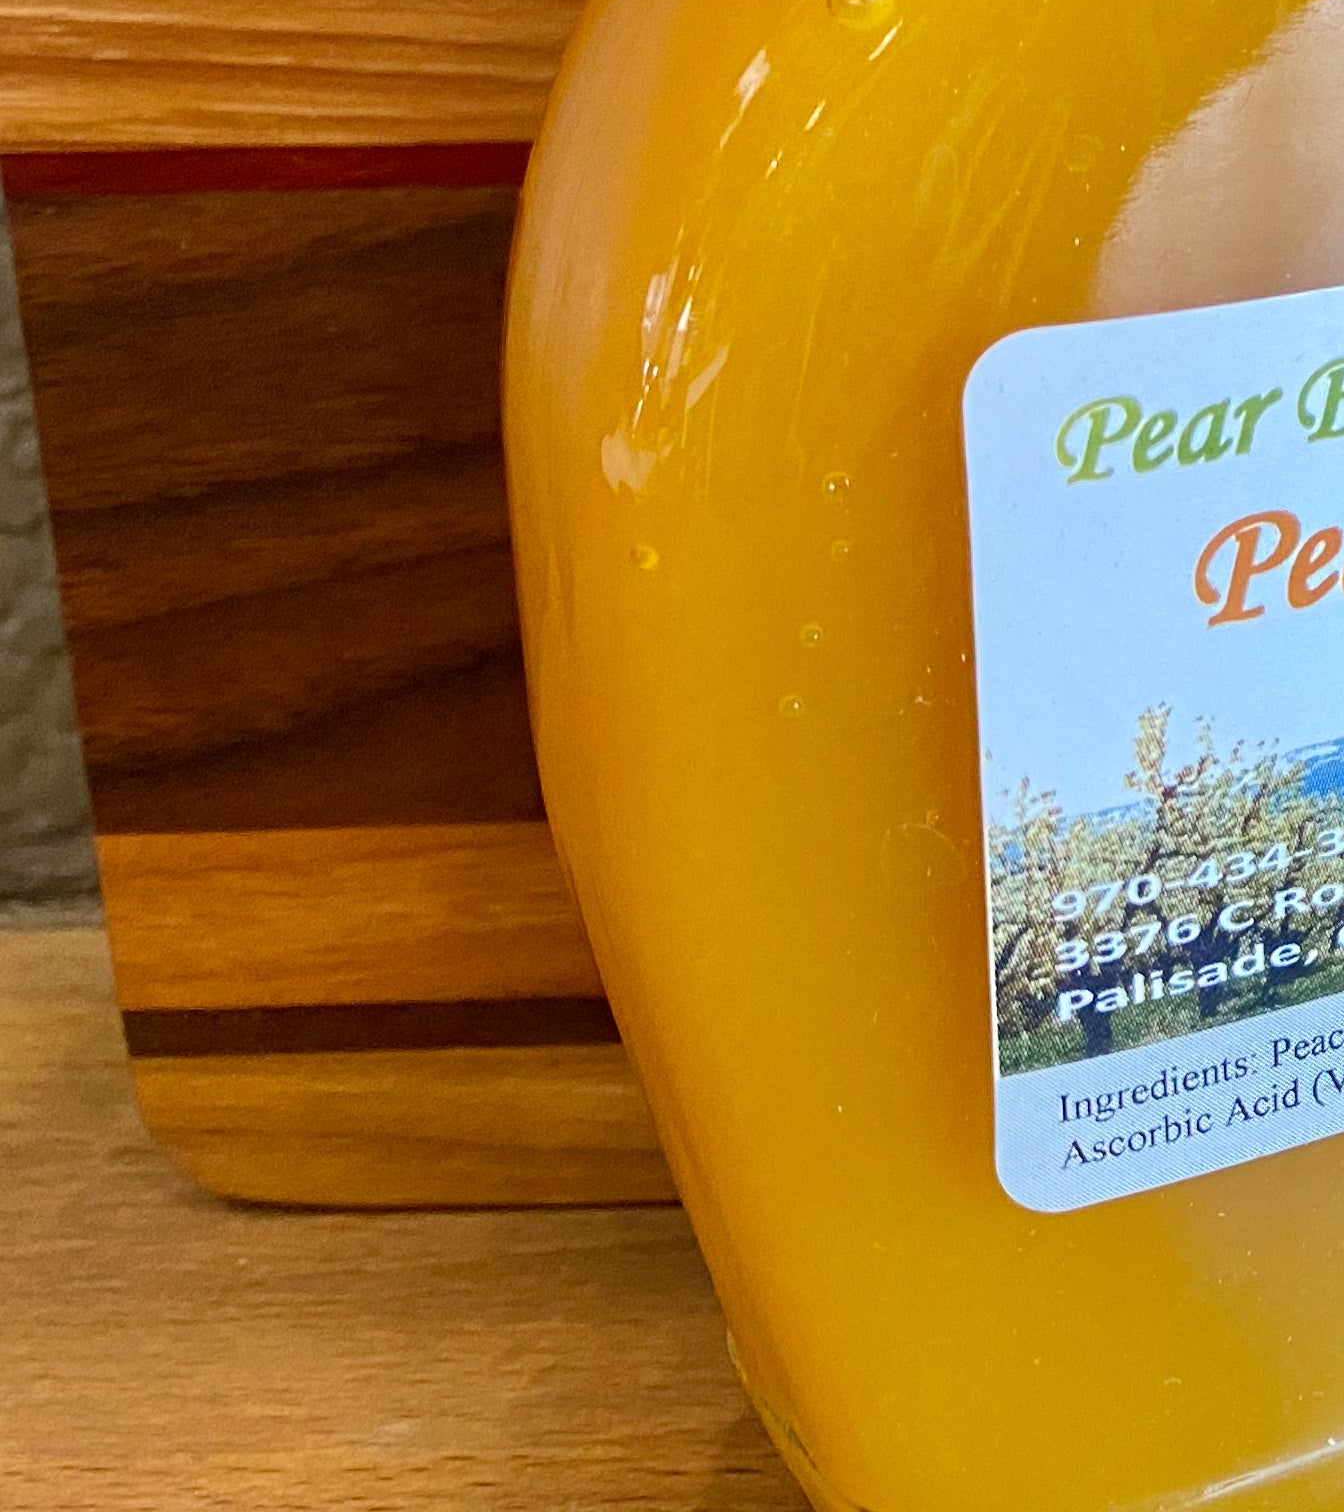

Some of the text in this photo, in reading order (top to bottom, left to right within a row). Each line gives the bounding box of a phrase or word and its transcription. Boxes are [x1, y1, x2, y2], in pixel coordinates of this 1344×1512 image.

[1056, 387, 1283, 487] Pear
[1053, 914, 1201, 974] 3376
[1217, 903, 1254, 934] C
[1057, 944, 1318, 1022] Palisade,
[1058, 1052, 1259, 1123] Ingredients:
[1060, 1108, 1213, 1169] Ascorbic
[1226, 1080, 1300, 1123] Acid
